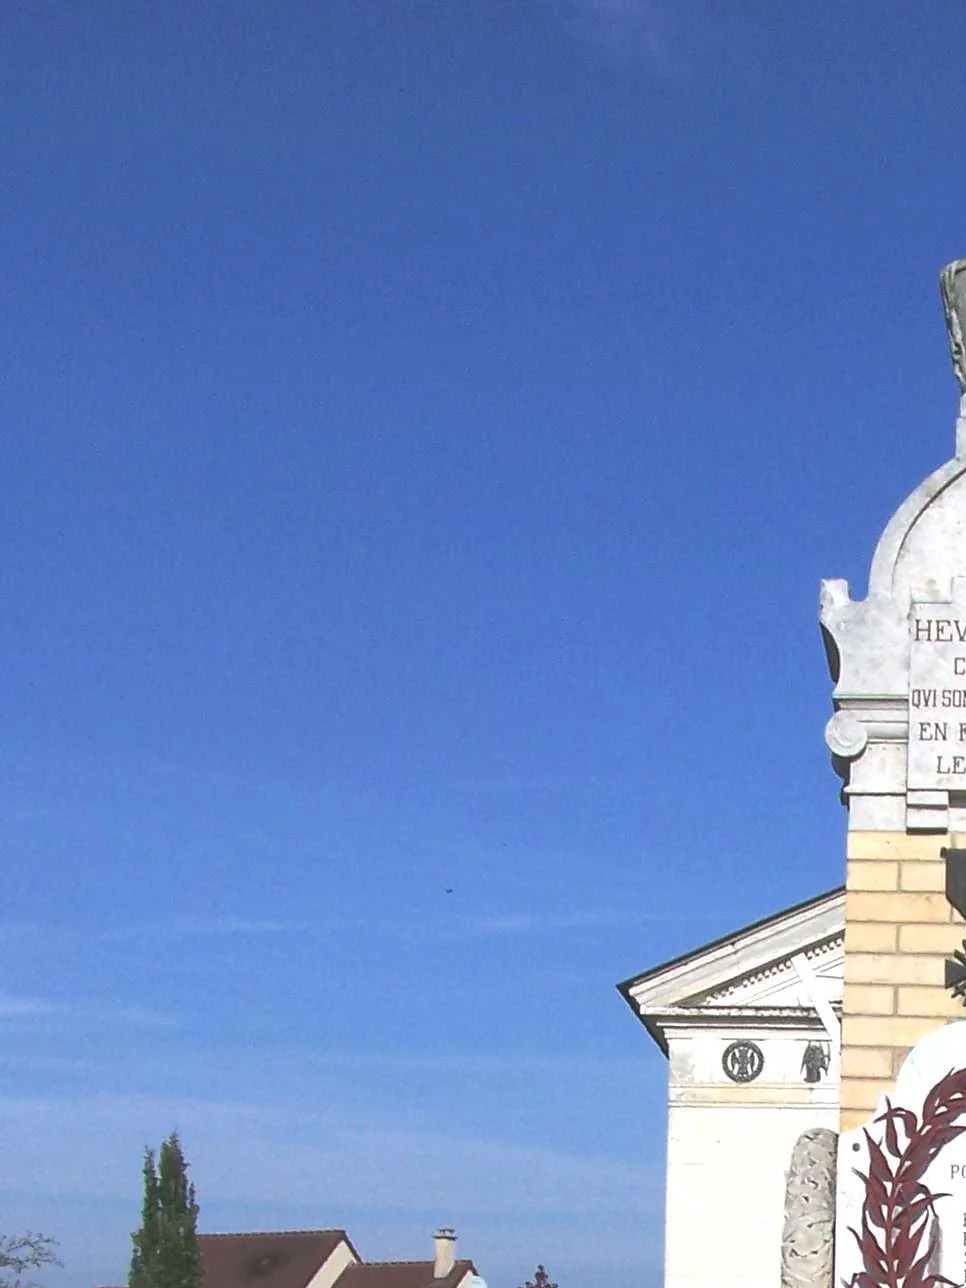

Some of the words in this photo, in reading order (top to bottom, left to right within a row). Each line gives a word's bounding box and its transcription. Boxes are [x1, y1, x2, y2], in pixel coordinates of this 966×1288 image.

[911, 689, 937, 708] QVI
[919, 722, 948, 741] EN
[936, 755, 966, 774] LE
